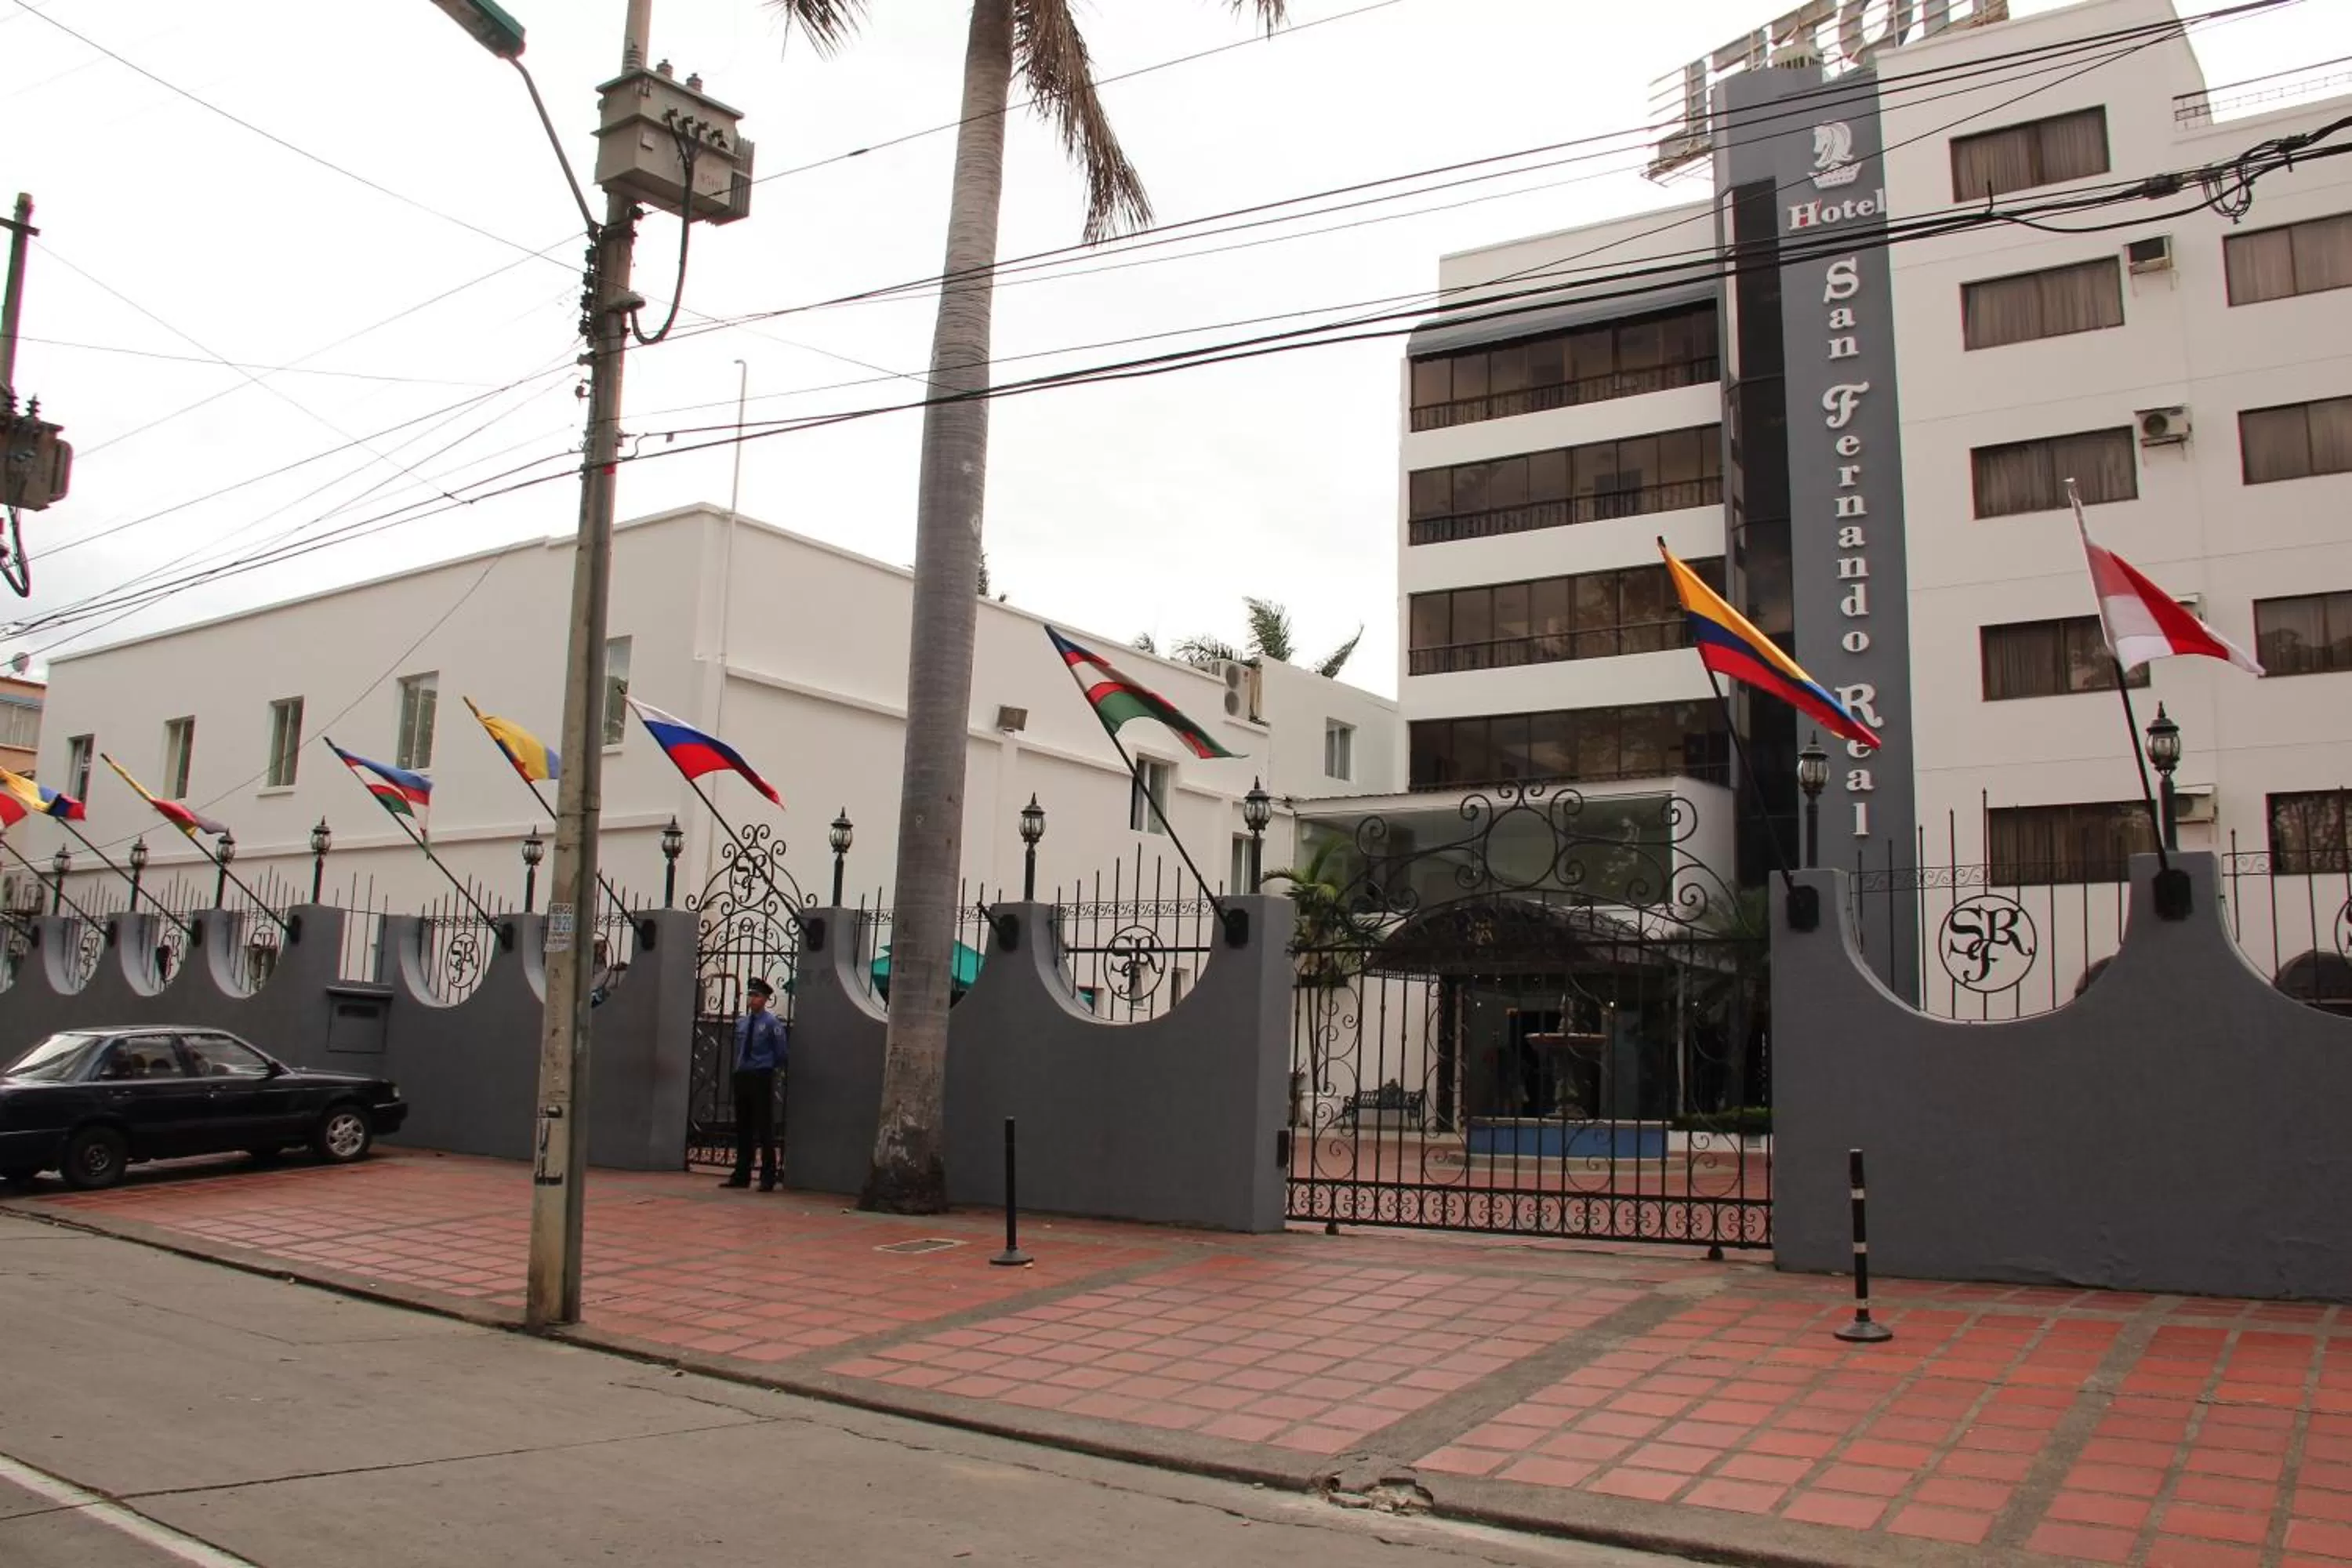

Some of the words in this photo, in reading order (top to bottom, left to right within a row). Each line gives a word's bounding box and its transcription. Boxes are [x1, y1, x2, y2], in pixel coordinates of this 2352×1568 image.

[1788, 188, 1886, 231] Hotel
[1823, 256, 1860, 360] San
[1822, 381, 1870, 653] Fernando
[1835, 683, 1885, 837] Real
